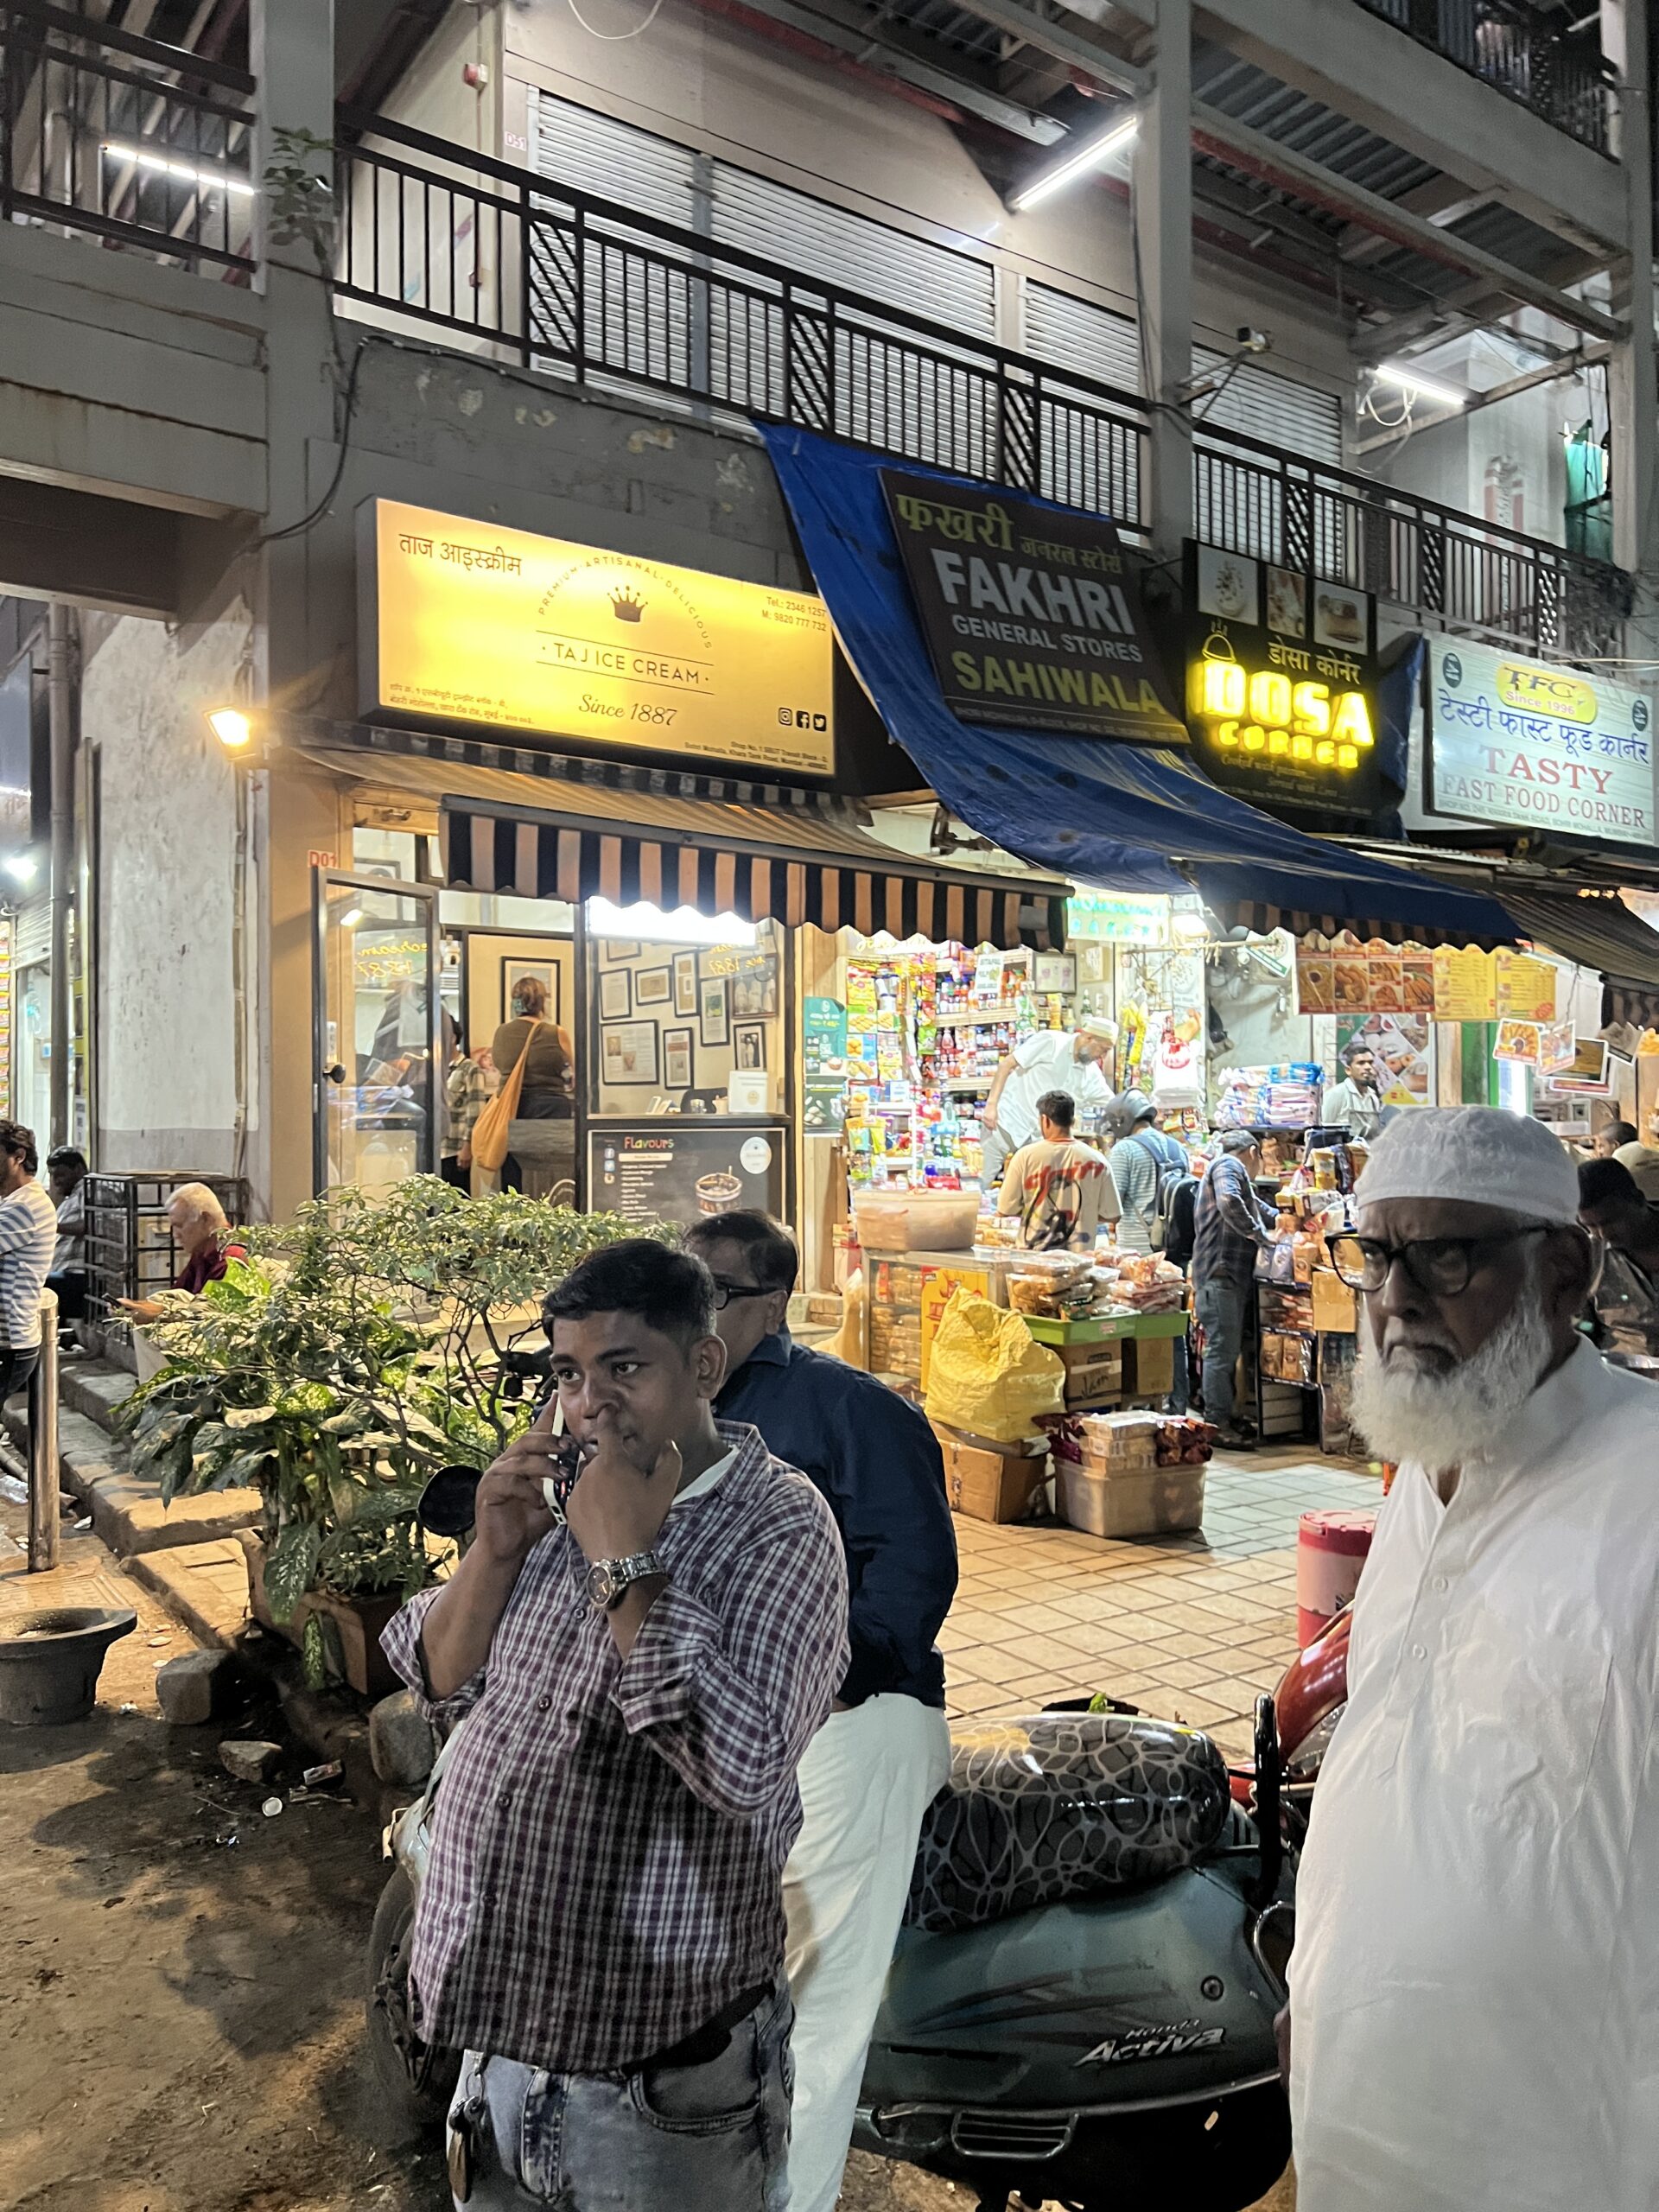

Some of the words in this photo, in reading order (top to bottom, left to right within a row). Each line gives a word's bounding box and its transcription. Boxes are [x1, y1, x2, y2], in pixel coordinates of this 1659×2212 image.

[398, 533, 434, 558] ताज
[439, 543, 522, 575] आइस्क्रीम
[538, 567, 577, 615] PREMIUM
[586, 556, 658, 579] ARTISANAL
[665, 580, 712, 649] DELICIOUS
[931, 548, 1136, 635] FAKHRI
[773, 612, 793, 624] 9820
[796, 617, 810, 627] 777
[812, 620, 827, 632] 732
[951, 614, 1058, 651] GENERAL
[1060, 633, 1143, 663] STORES
[553, 642, 588, 663] TAJ
[596, 650, 626, 671] ICE
[632, 658, 699, 684] CREAM
[1267, 635, 1311, 671] डोसा
[951, 650, 1167, 715] SAHIWALA
[1203, 658, 1374, 747] DOSA
[1506, 690, 1541, 707] Since
[1548, 701, 1575, 715] 1996
[578, 694, 625, 718] Since
[630, 703, 677, 726] 1887
[1438, 688, 1492, 730] टेस्टी
[1498, 710, 1553, 742] फास्ट
[1559, 724, 1593, 757] फूड
[1599, 732, 1649, 764] कार्नर
[1218, 721, 1358, 769] CORNER
[1478, 744, 1613, 795] TASTY
[1442, 773, 1497, 803] FAST
[1504, 785, 1560, 813] FOOD
[1567, 797, 1646, 829] CORNER
[1073, 2027, 1225, 2067] Activa
